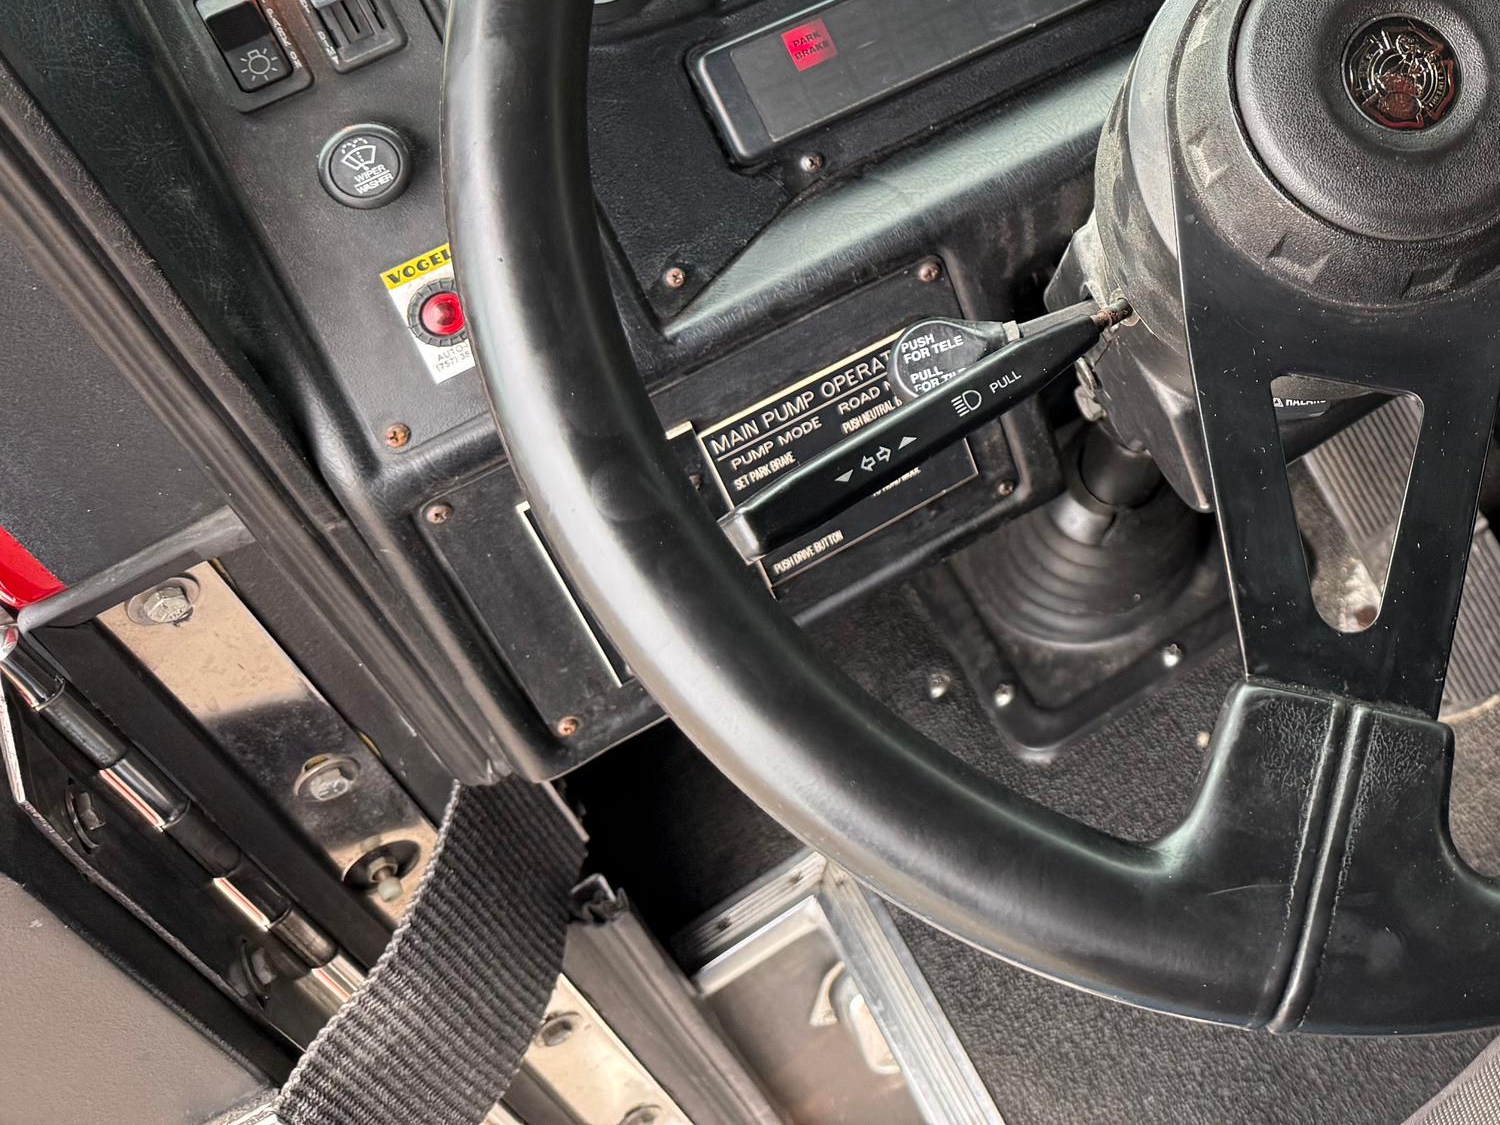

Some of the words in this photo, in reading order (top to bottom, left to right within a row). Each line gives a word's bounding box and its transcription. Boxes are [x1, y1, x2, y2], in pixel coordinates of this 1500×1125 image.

[793, 30, 821, 47] PARK
[795, 39, 830, 60] BRAKE
[354, 164, 386, 183] WIPER
[355, 173, 394, 195] WASHER
[386, 249, 452, 285] VOGEL
[901, 333, 935, 353] PUSH
[903, 347, 931, 364] FOR
[931, 335, 964, 354] TELE
[910, 366, 943, 384] PULL
[914, 376, 940, 393] FOR
[989, 371, 1022, 393] PULL
[710, 420, 760, 455] MAIN
[762, 390, 815, 428] PUMP
[821, 349, 892, 397] OPERAT
[838, 386, 881, 415] ROAD
[841, 418, 864, 435] PUSH
[863, 401, 895, 427] NEUTRAL
[731, 441, 774, 470] PUMP
[778, 416, 823, 446] MODE
[733, 475, 750, 491] SET
[749, 465, 772, 484] PARK
[771, 451, 796, 471] BRAKE
[773, 555, 794, 574] PUSH
[793, 543, 815, 562] DRIVE
[813, 530, 844, 555] BUTTON
